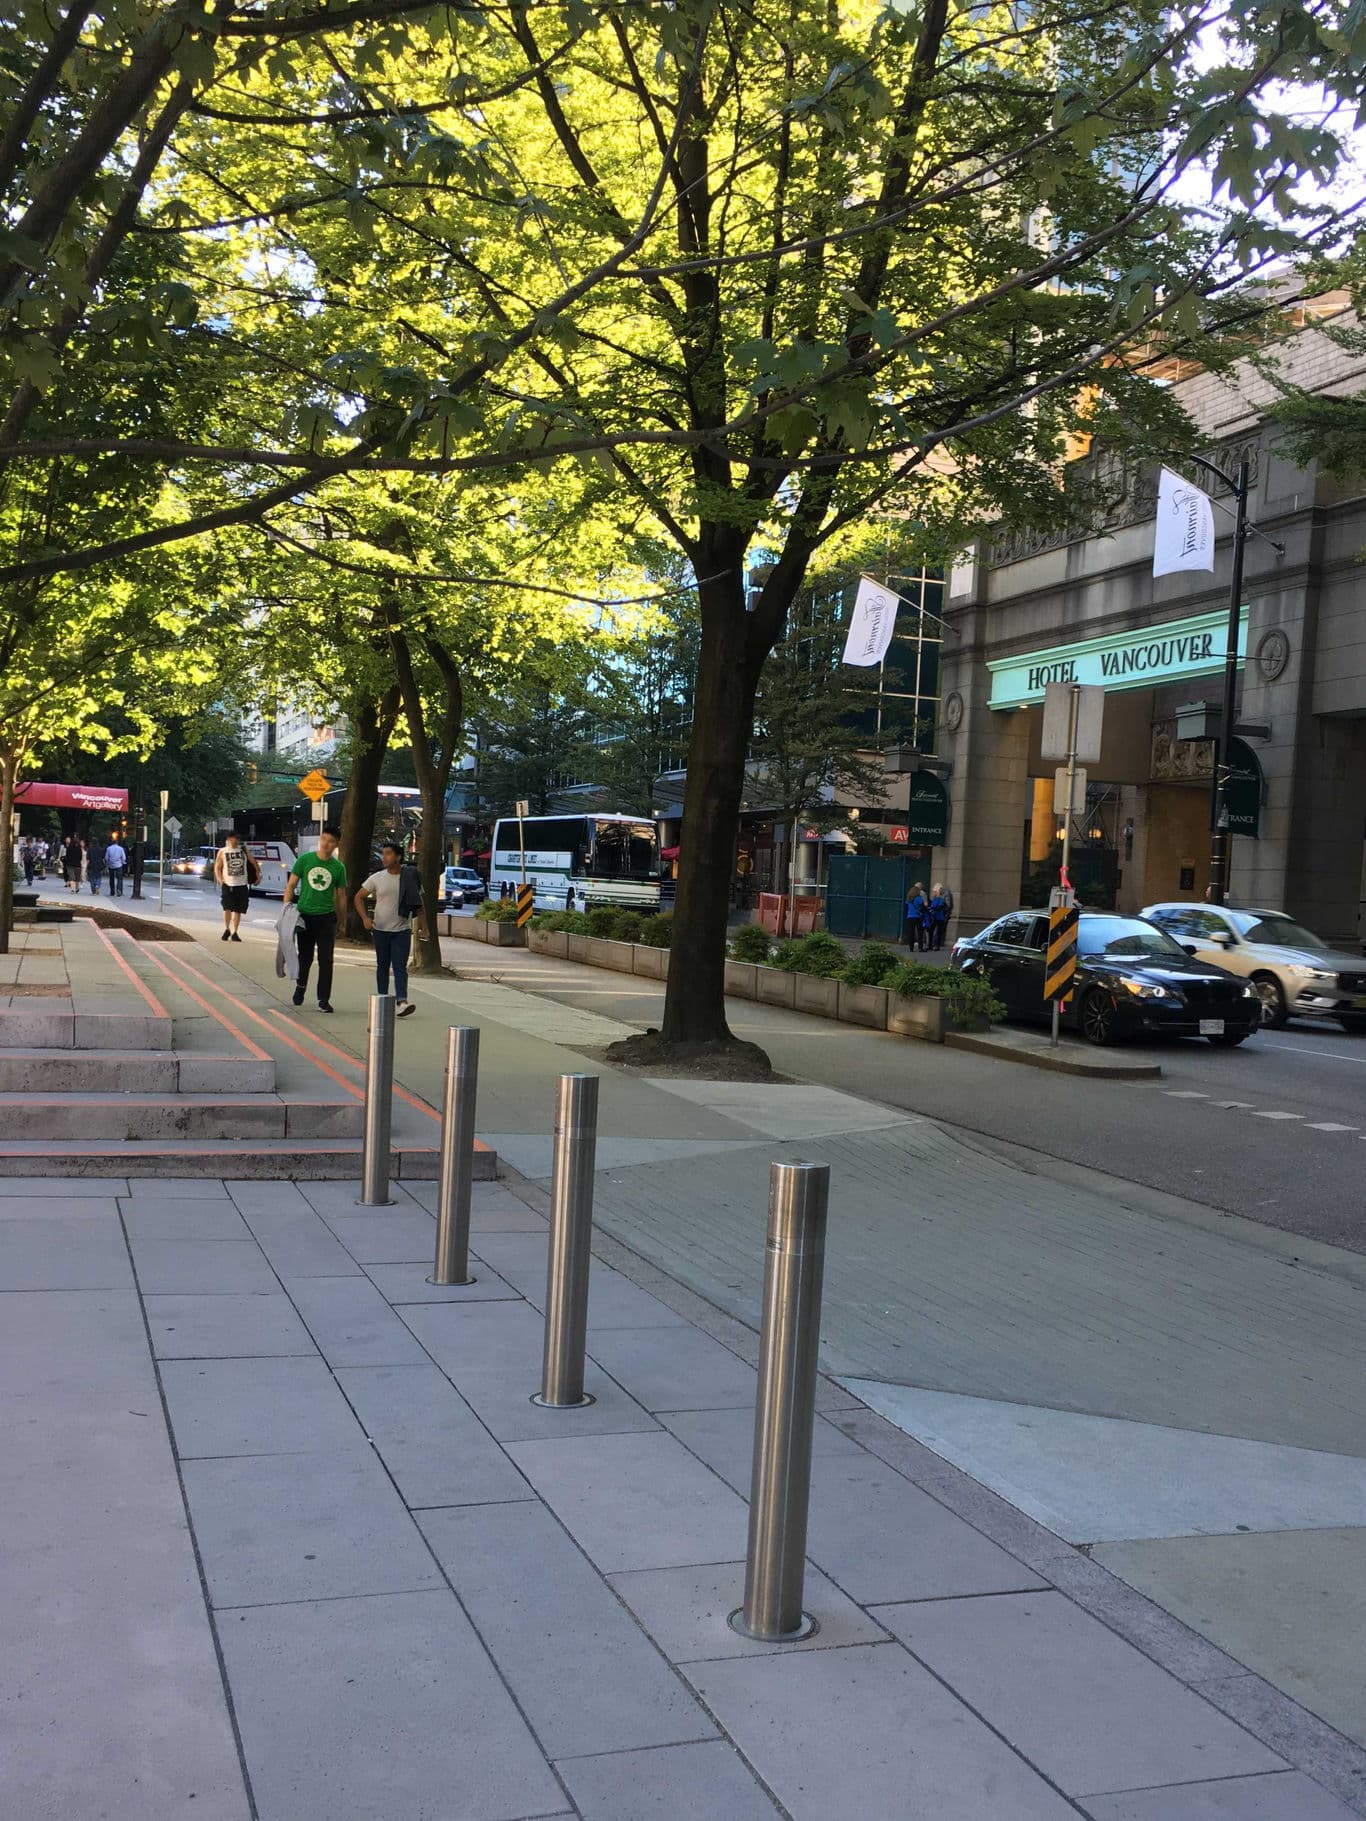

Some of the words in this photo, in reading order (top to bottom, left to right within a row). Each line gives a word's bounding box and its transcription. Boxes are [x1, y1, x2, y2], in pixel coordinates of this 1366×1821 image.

[1027, 659, 1079, 691] HOTEL
[1100, 633, 1213, 677] VANCOUVER
[894, 830, 908, 841] AV
